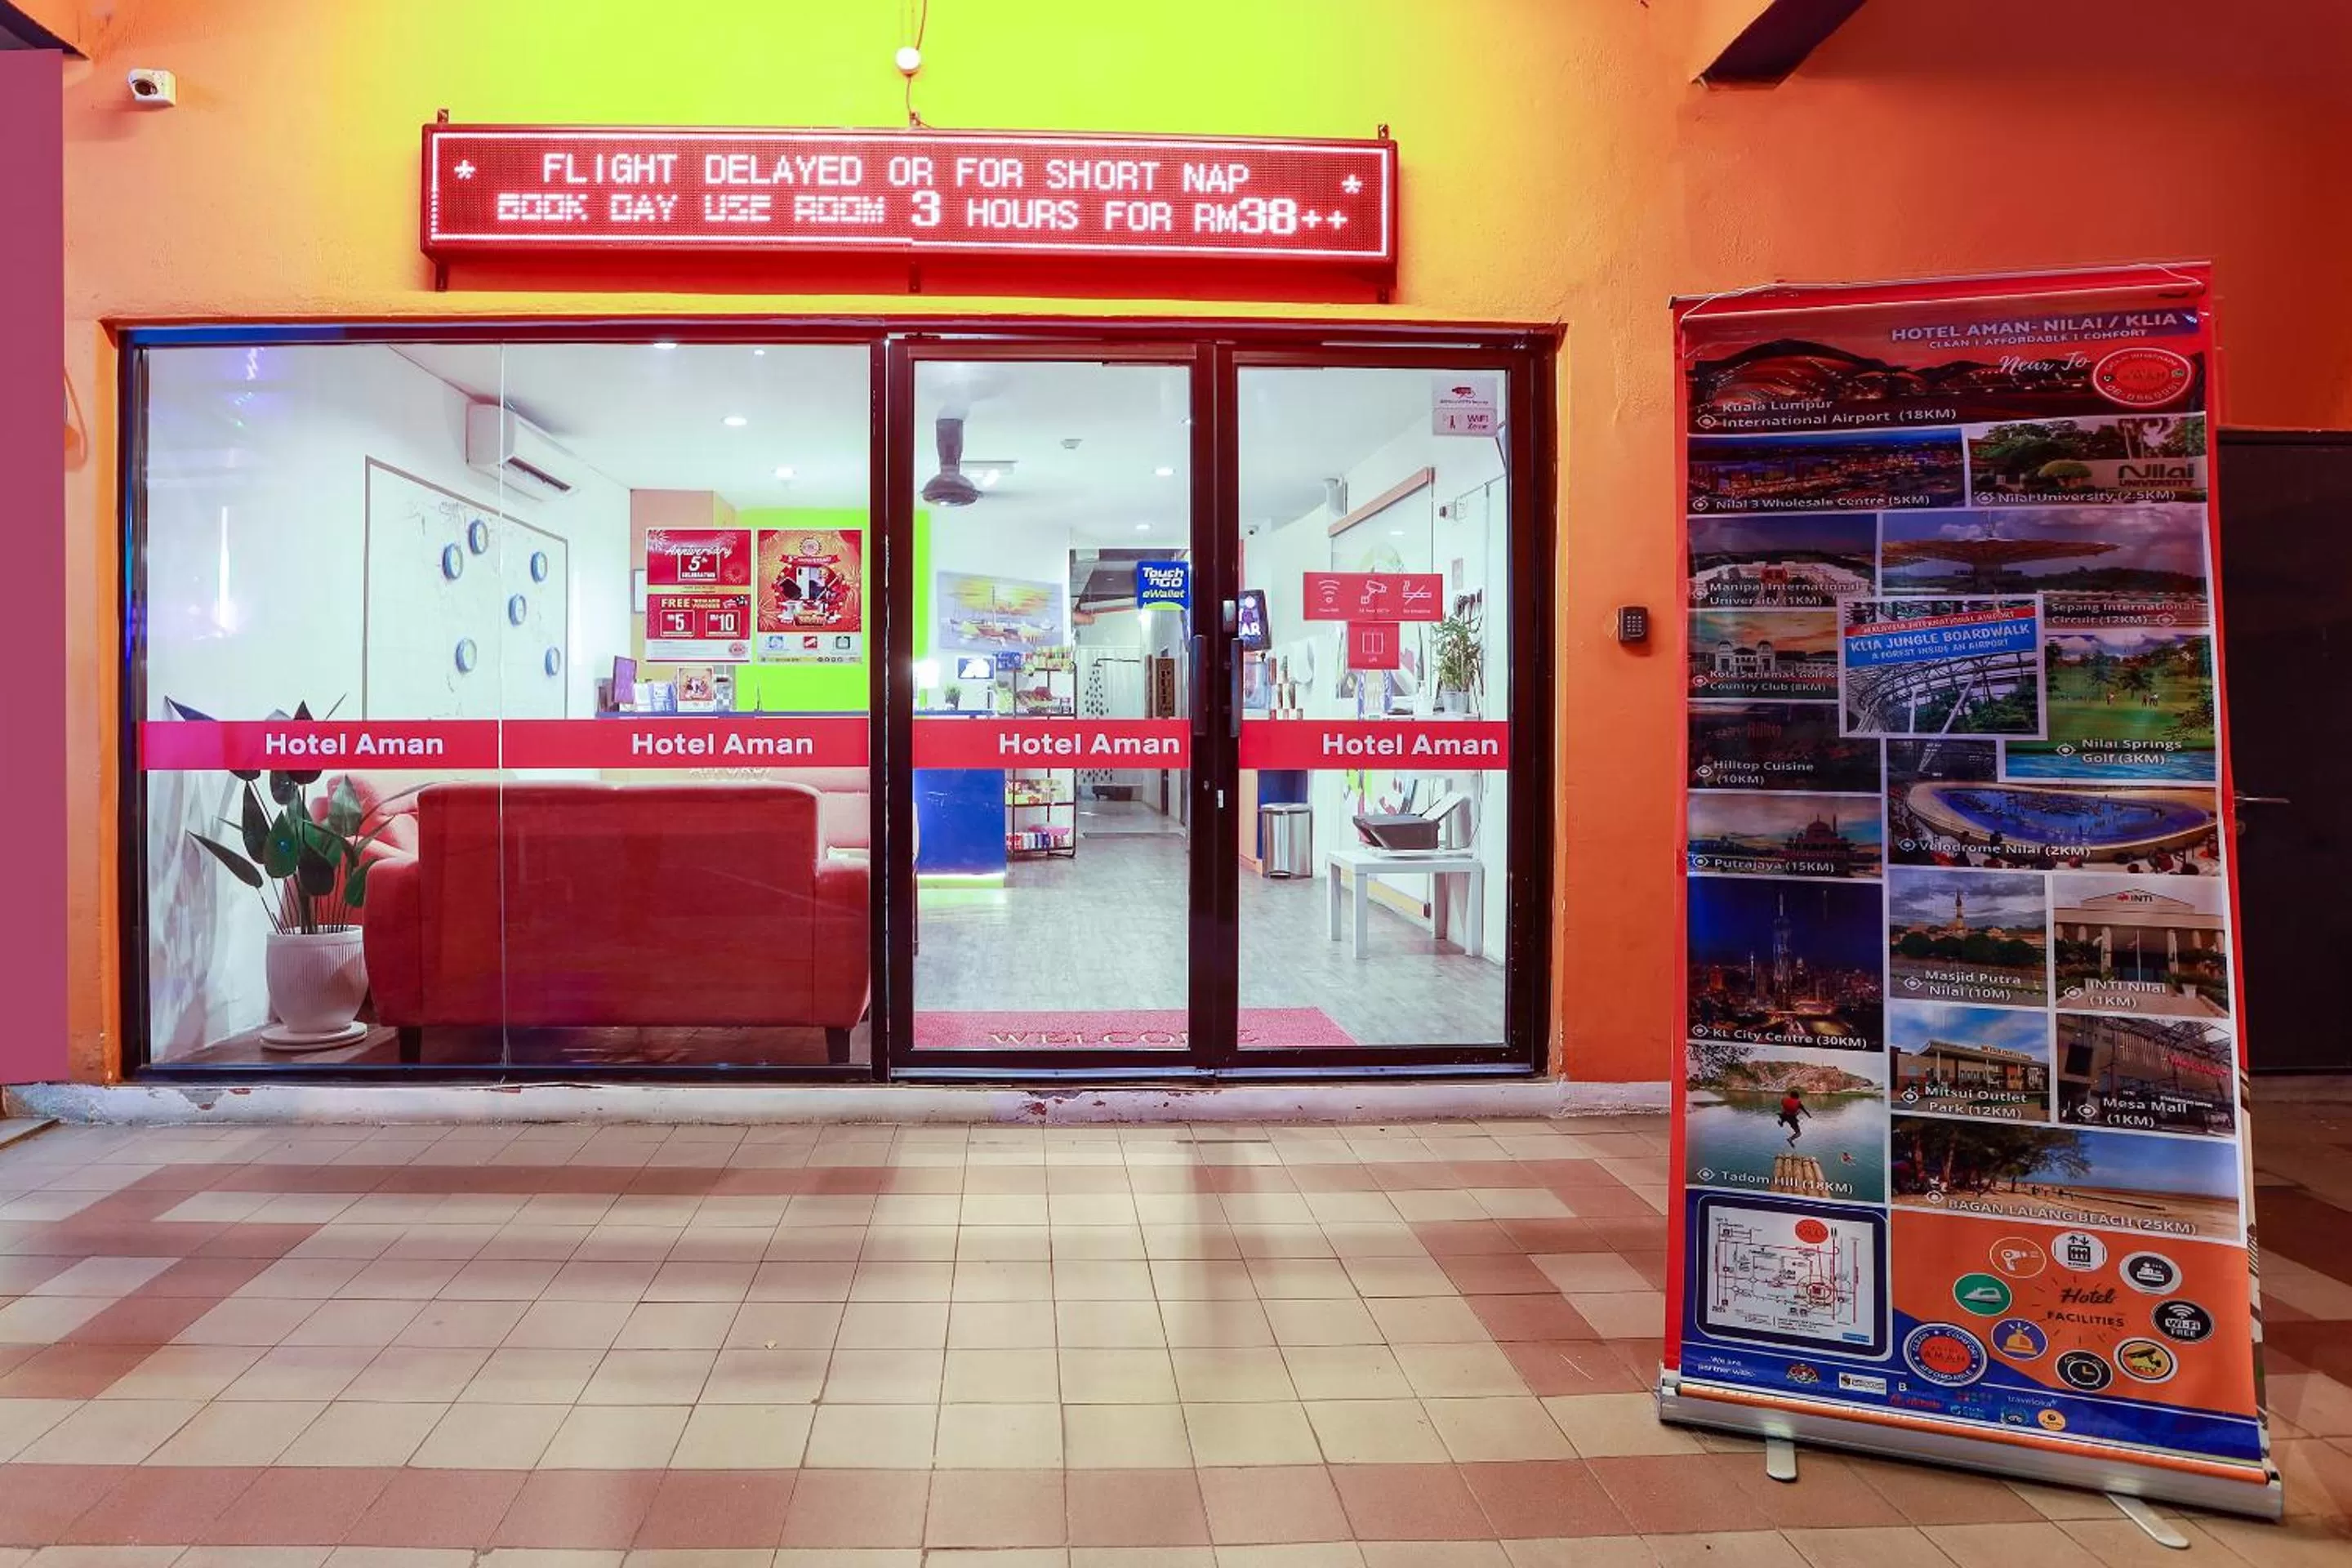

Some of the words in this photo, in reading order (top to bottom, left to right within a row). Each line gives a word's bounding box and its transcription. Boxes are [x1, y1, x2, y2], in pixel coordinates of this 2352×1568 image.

[543, 153, 678, 184] FLIGHT
[705, 154, 862, 186] DELAYED
[888, 155, 933, 187] OR
[956, 158, 1023, 189] FOR
[1046, 159, 1160, 191] SHORT
[1183, 163, 1250, 194] NAP
[610, 194, 679, 223] DAY
[704, 194, 772, 223] USE
[911, 190, 942, 227] 3
[967, 199, 1079, 231] HOURS
[1105, 200, 1173, 232] FOR
[1891, 326, 1967, 342] HOTEL
[2043, 316, 2102, 333] NILAI
[2124, 313, 2178, 328] KLIA
[1928, 339, 1970, 350] CLEAN
[1984, 332, 2069, 347] AFFORDABLE
[2083, 328, 2148, 341] COMFORT
[1998, 354, 2055, 376] Near
[1722, 402, 1766, 414] Kuala
[1771, 400, 1833, 413] Lumpur
[1722, 415, 1827, 428] International
[1833, 411, 1891, 425] Airport
[1899, 408, 1958, 422] (18KM)
[2118, 479, 2194, 488] UNIVERSITY
[1716, 498, 1748, 510] Nilai
[1765, 497, 1833, 509] Wholesale
[1838, 496, 1886, 506] Centre
[1889, 494, 1931, 506] (5KM)
[2037, 491, 2115, 503] University
[1143, 567, 1184, 578] Touch
[1143, 589, 1186, 598] eWallet
[1710, 582, 1764, 594] Manipal
[1767, 581, 1860, 591] International
[662, 598, 690, 608] FREE
[1710, 596, 1780, 608] University
[1783, 596, 1823, 607] (1KM)
[2051, 602, 2100, 613] Sepang
[2103, 602, 2196, 612] International
[1863, 621, 1907, 634] MALAYSIA
[1907, 615, 1976, 630] INTERNATIONAL
[1977, 611, 2016, 622] AIRPORT
[2051, 615, 2096, 624] Circuit
[1850, 640, 1882, 653] KLIA
[1886, 633, 1939, 649] JUNGLE
[1944, 623, 2030, 644] BOARDWALK
[1881, 648, 1915, 659] FOREST
[1953, 643, 1966, 652] AN
[1968, 639, 2009, 651] AIRPORT
[1710, 670, 1737, 679] Kota
[1710, 682, 1757, 693] Country
[1761, 681, 1789, 692] Club
[265, 732, 346, 756] Hotel
[354, 732, 444, 756] Aman
[631, 733, 715, 755] Hotel
[723, 733, 813, 755] Aman
[999, 733, 1081, 755] Hotel
[1090, 733, 1180, 755] Aman
[1322, 733, 1403, 755] Hotel
[1411, 733, 1499, 755] Aman
[2082, 738, 2118, 749] Nilai
[2123, 739, 2183, 752] Springs
[1714, 760, 1760, 772] Hilltop
[1763, 761, 1814, 772] Cuisine
[2082, 753, 2114, 764] Golf
[2118, 753, 2166, 765] (3KM)
[1717, 775, 1765, 786] (10KM)
[1919, 842, 2002, 855] Velodrome
[2005, 844, 2042, 856] Nilai
[2045, 844, 2091, 858] (2KM)
[1714, 858, 1783, 871] Putrajaya
[1785, 861, 1835, 873] (15KM)
[2131, 894, 2154, 902] INTI
[1925, 969, 1976, 985] Masjid
[1980, 972, 2021, 985] Putra
[1929, 984, 1965, 997] Nilai
[1968, 986, 2011, 1001] (10M)
[2089, 978, 2123, 991] INTI
[2130, 981, 2167, 994] Nilai
[2089, 995, 2137, 1009] (1KM)
[1713, 1027, 1730, 1038] KL
[1734, 1029, 1762, 1043] City
[1765, 1031, 1814, 1045] Centre
[1816, 1036, 1867, 1049] (30KM)
[1925, 1085, 1973, 1099] Mitsui
[1979, 1090, 2028, 1104] Outlet
[1929, 1101, 1965, 1114] Park
[1968, 1103, 2023, 1120] (12KM)
[2150, 1101, 2188, 1114] Mall
[2107, 1113, 2155, 1128] (1KM)
[1721, 1170, 1770, 1185] Tadom
[1774, 1174, 1798, 1188] Hill
[1802, 1180, 1854, 1195] (18KM)
[1948, 1198, 2005, 1214] BAGAN
[2008, 1205, 2074, 1222] LALANG
[2078, 1211, 2133, 1228] BEACH
[2136, 1218, 2198, 1236] (25KM)
[2060, 1287, 2117, 1304] Hotel
[2047, 1310, 2124, 1328] FACILITIES
[2171, 1328, 2197, 1338] FREE
